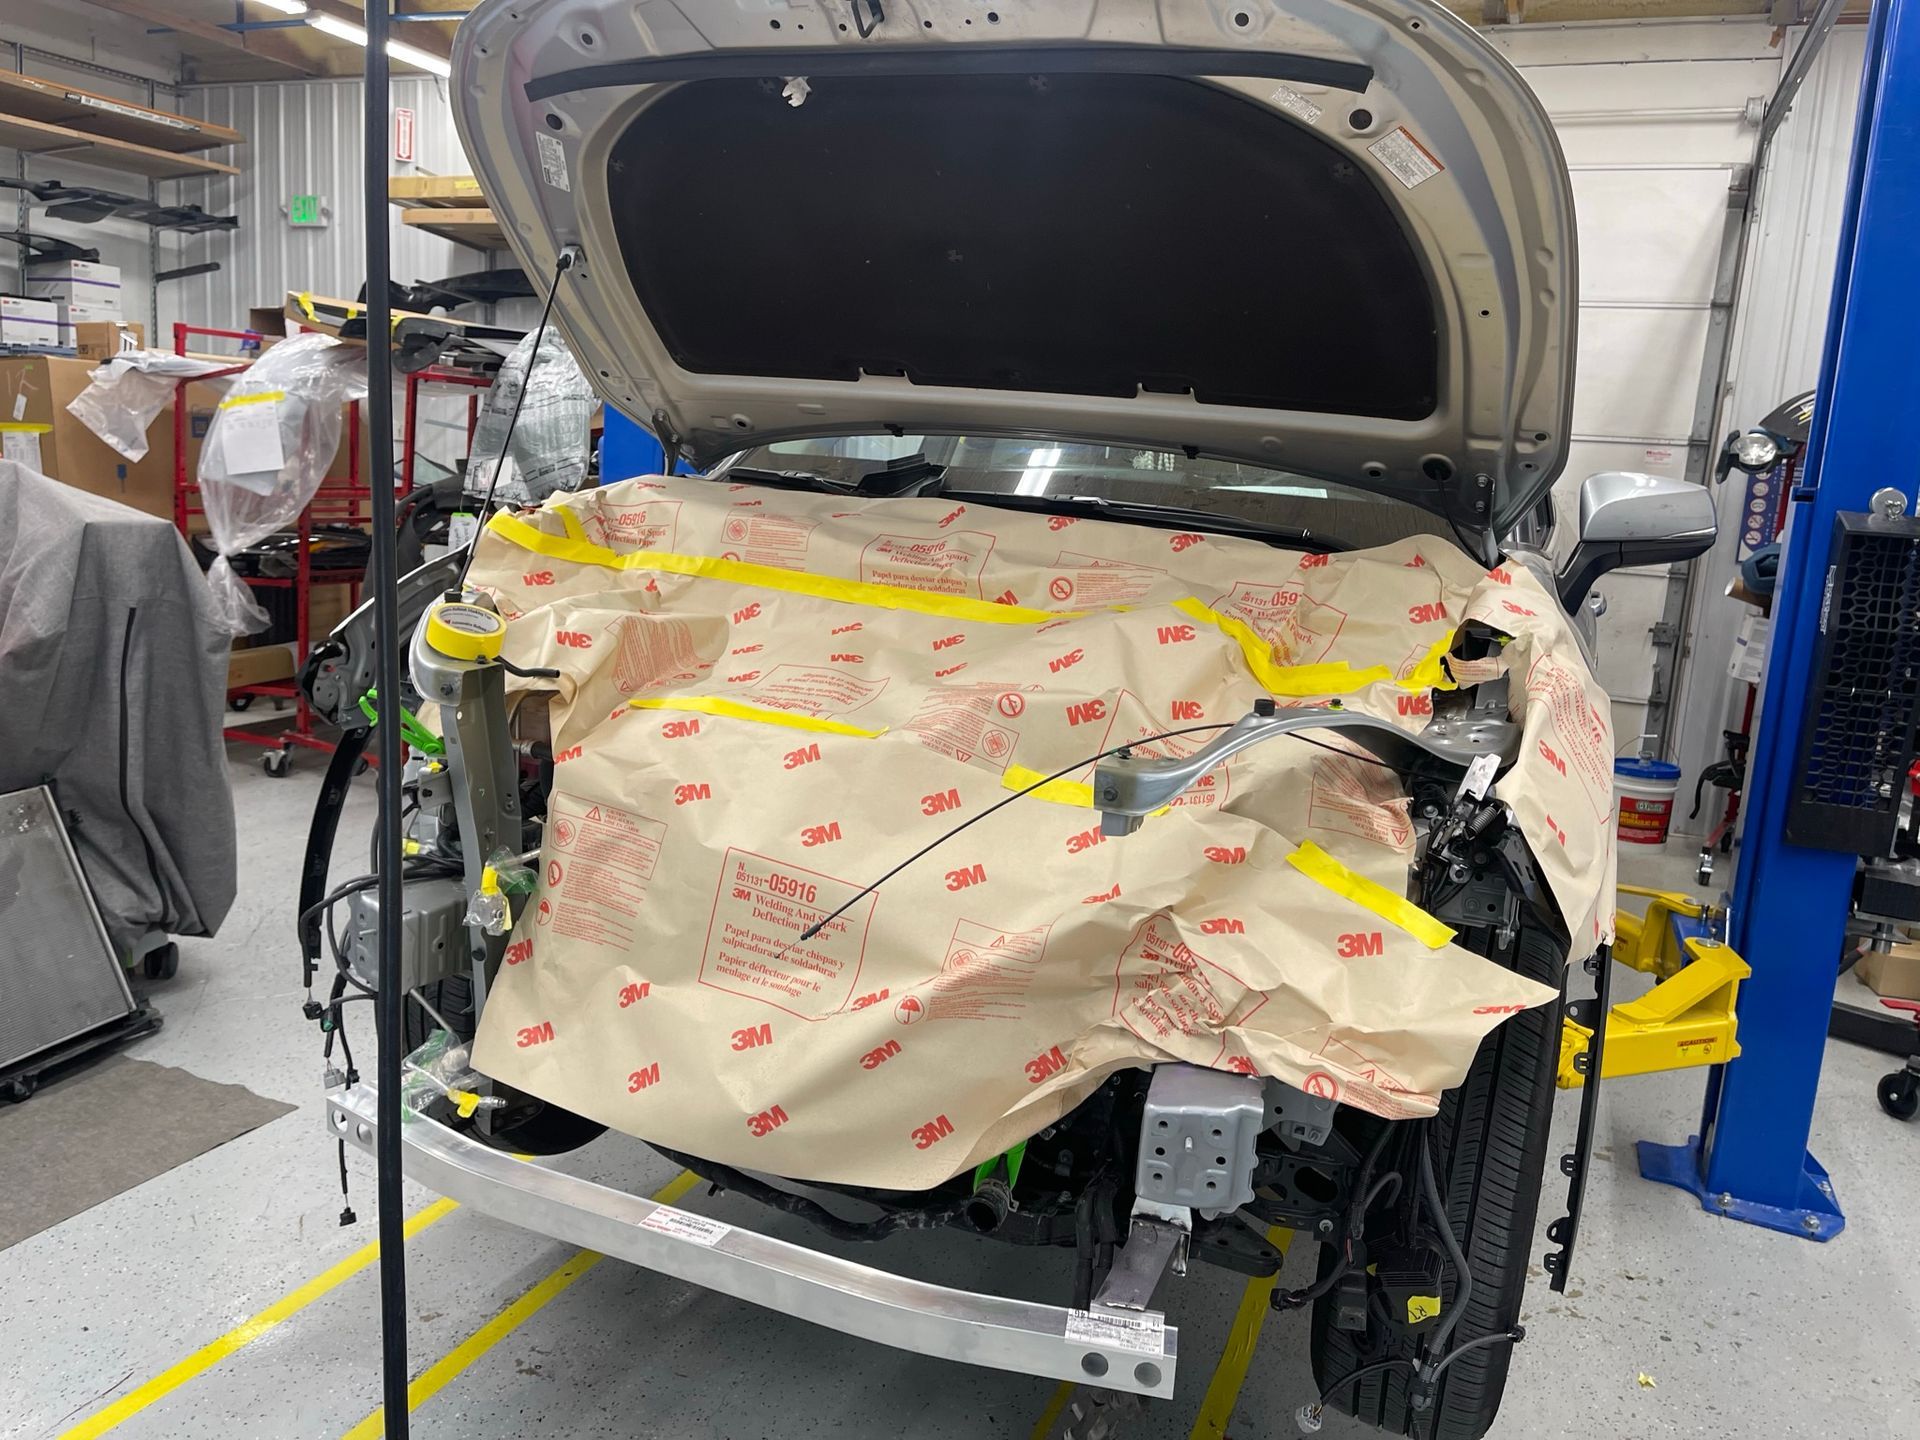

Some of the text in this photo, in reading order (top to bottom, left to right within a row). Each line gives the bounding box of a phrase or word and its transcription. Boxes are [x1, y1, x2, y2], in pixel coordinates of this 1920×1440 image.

[291, 194, 319, 222] EXIT
[938, 505, 966, 528] 3M
[1170, 534, 1205, 552] 3M
[945, 554, 969, 564] Spark
[523, 571, 555, 586] 3M
[872, 570, 892, 579] Papel
[927, 585, 966, 594] soldaduras
[734, 602, 761, 624] 3M
[1408, 602, 1447, 624] 3M
[556, 631, 592, 649] 3M
[932, 634, 966, 651] 3M
[1158, 625, 1196, 644] 3M
[1048, 648, 1084, 673] 3M
[1066, 699, 1107, 726] 3M
[1171, 701, 1204, 720] 3M
[662, 718, 701, 739] 3M
[784, 743, 821, 769] 3M
[674, 783, 711, 805] 3M
[1197, 775, 1215, 787] 3M
[920, 788, 962, 816] 3M
[801, 821, 842, 848] 3M
[1065, 825, 1106, 853] 3M
[738, 862, 746, 872] N.
[1203, 847, 1245, 864] 3M
[736, 871, 817, 903] 051131-05916
[944, 863, 987, 892] 3M
[732, 887, 752, 901] 3M
[755, 895, 794, 917] Welding
[796, 908, 816, 922] And
[752, 907, 800, 931] Deflection
[1200, 917, 1245, 935] 3M
[506, 938, 533, 966] 3M
[722, 936, 837, 979] salpicaduras de soldaduras
[724, 923, 750, 938] Papel
[751, 932, 772, 945] para
[806, 948, 838, 967] chispas
[838, 960, 846, 970] y
[1337, 932, 1384, 959] 3M
[716, 964, 751, 982] meulage
[760, 977, 769, 986] le
[769, 981, 802, 998] soudage
[719, 951, 822, 992] Papier déflecteur pour le
[618, 982, 650, 1009] 3M
[517, 1021, 554, 1048] 3M
[731, 1023, 773, 1051] 3M
[858, 1040, 902, 1071] 3M
[1024, 1045, 1069, 1084] 3M
[628, 1062, 660, 1093] 3M
[746, 1104, 789, 1138] 3M
[910, 1114, 954, 1150] 3M
